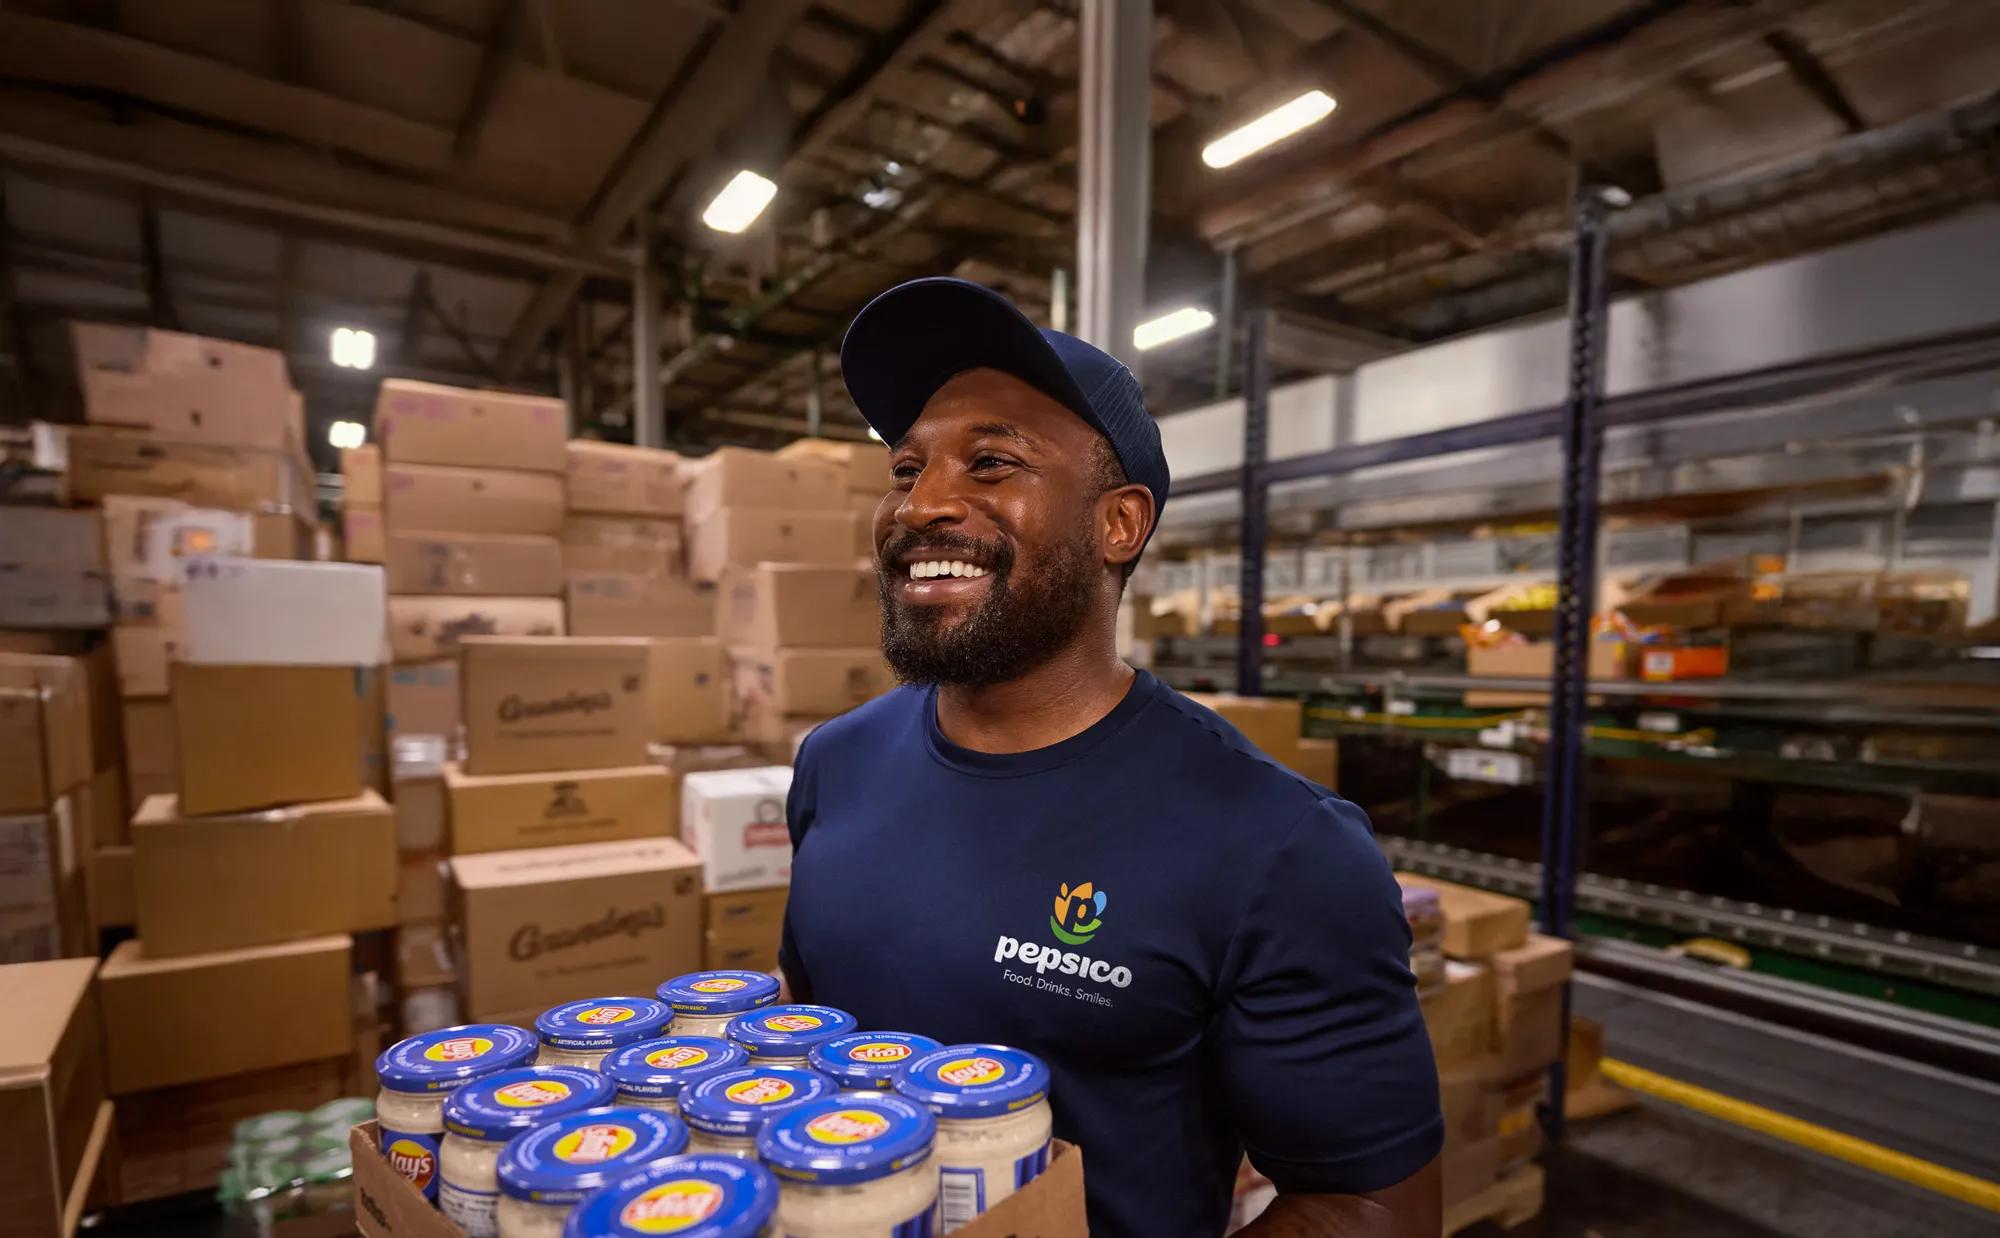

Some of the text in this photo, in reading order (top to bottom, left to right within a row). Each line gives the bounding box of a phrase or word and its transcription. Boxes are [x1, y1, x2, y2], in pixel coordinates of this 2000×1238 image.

[994, 936, 1133, 988] pepsico
[1003, 969, 1113, 1008] Food. Drinks. Smiles.
